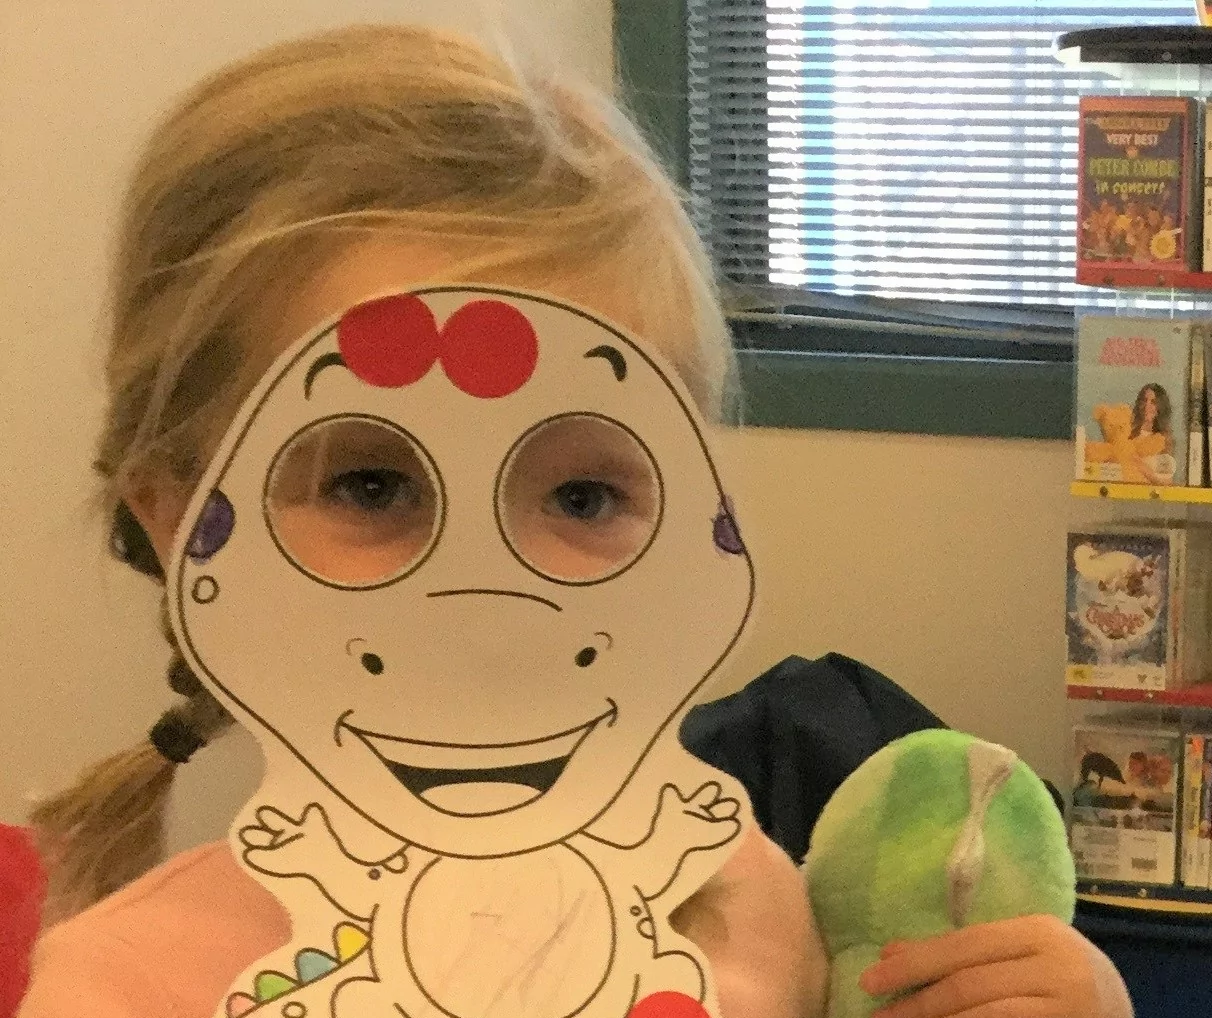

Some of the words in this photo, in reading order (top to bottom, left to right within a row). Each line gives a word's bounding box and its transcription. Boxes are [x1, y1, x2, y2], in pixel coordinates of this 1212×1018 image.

[1106, 133, 1132, 145] VERY
[1133, 133, 1158, 146] BEST
[1089, 157, 1130, 177] PETER
